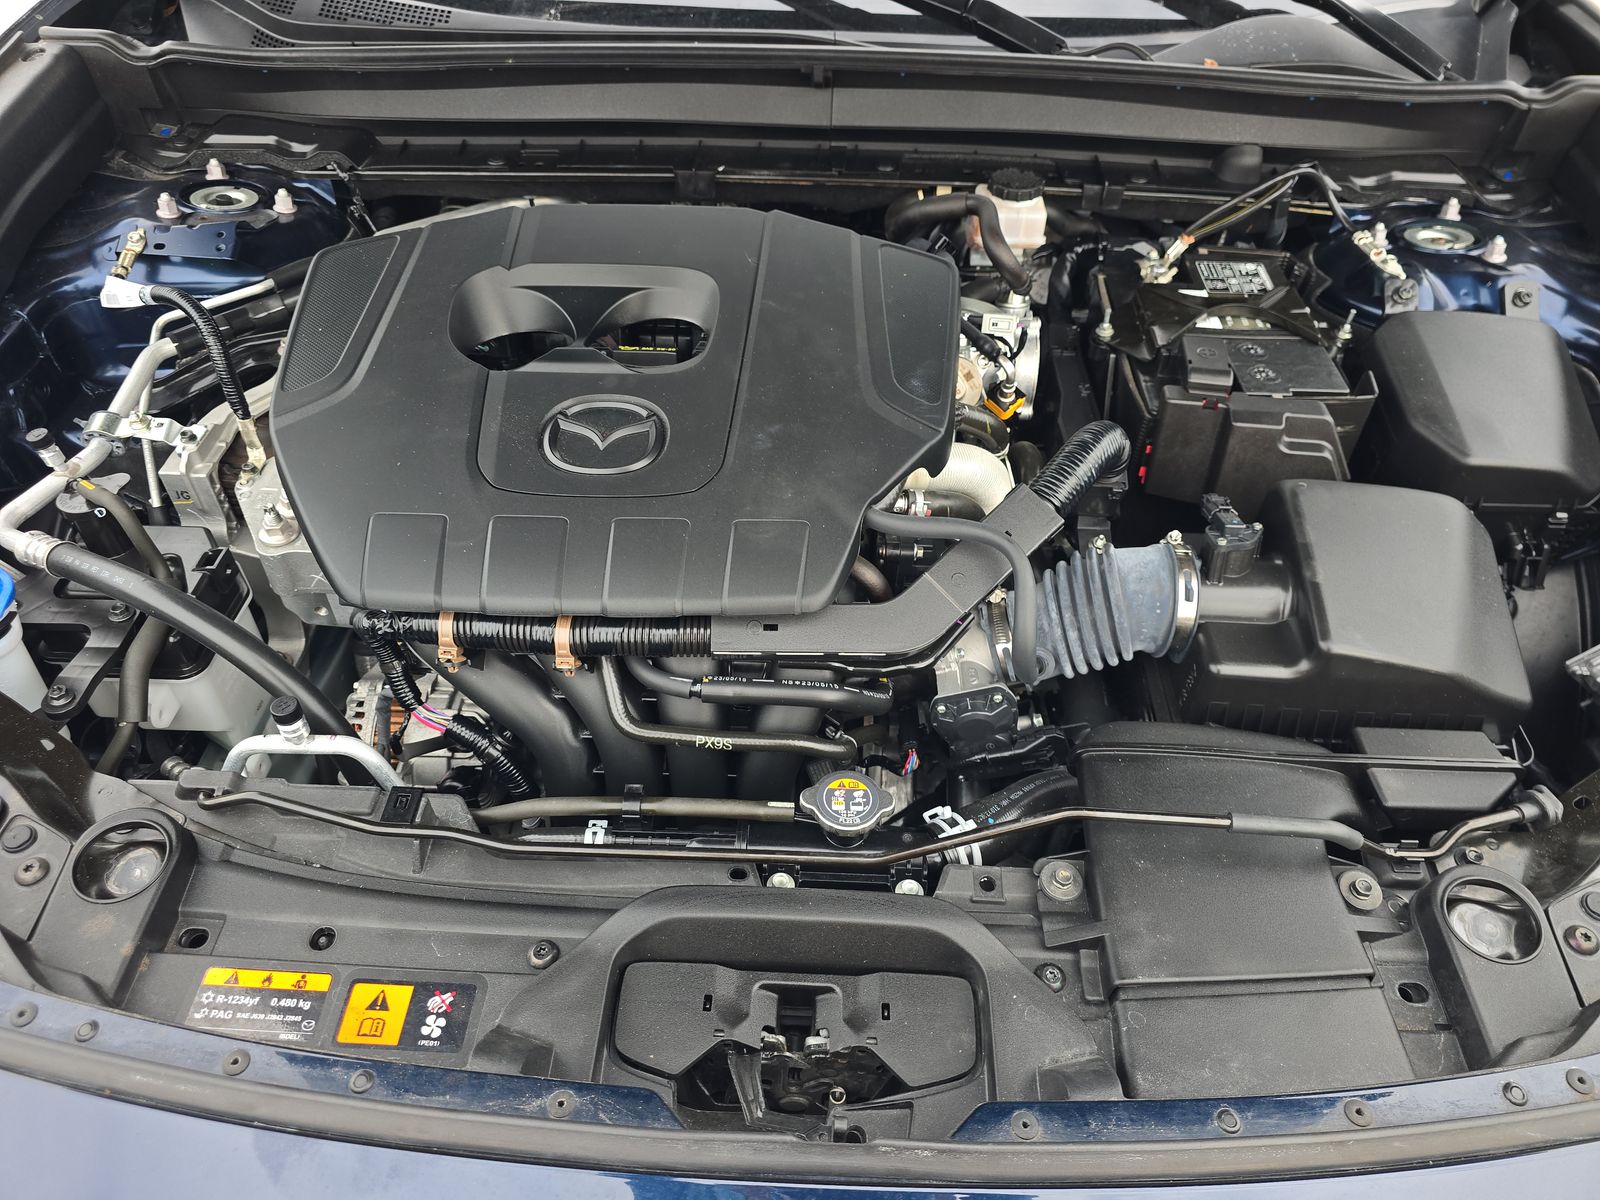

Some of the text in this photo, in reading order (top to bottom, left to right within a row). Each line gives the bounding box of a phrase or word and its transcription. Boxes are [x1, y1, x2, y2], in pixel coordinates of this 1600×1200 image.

[695, 735, 733, 751] PX9S
[215, 995, 312, 1010] R-1234yf 0.480 kg
[210, 1009, 233, 1019] PAG
